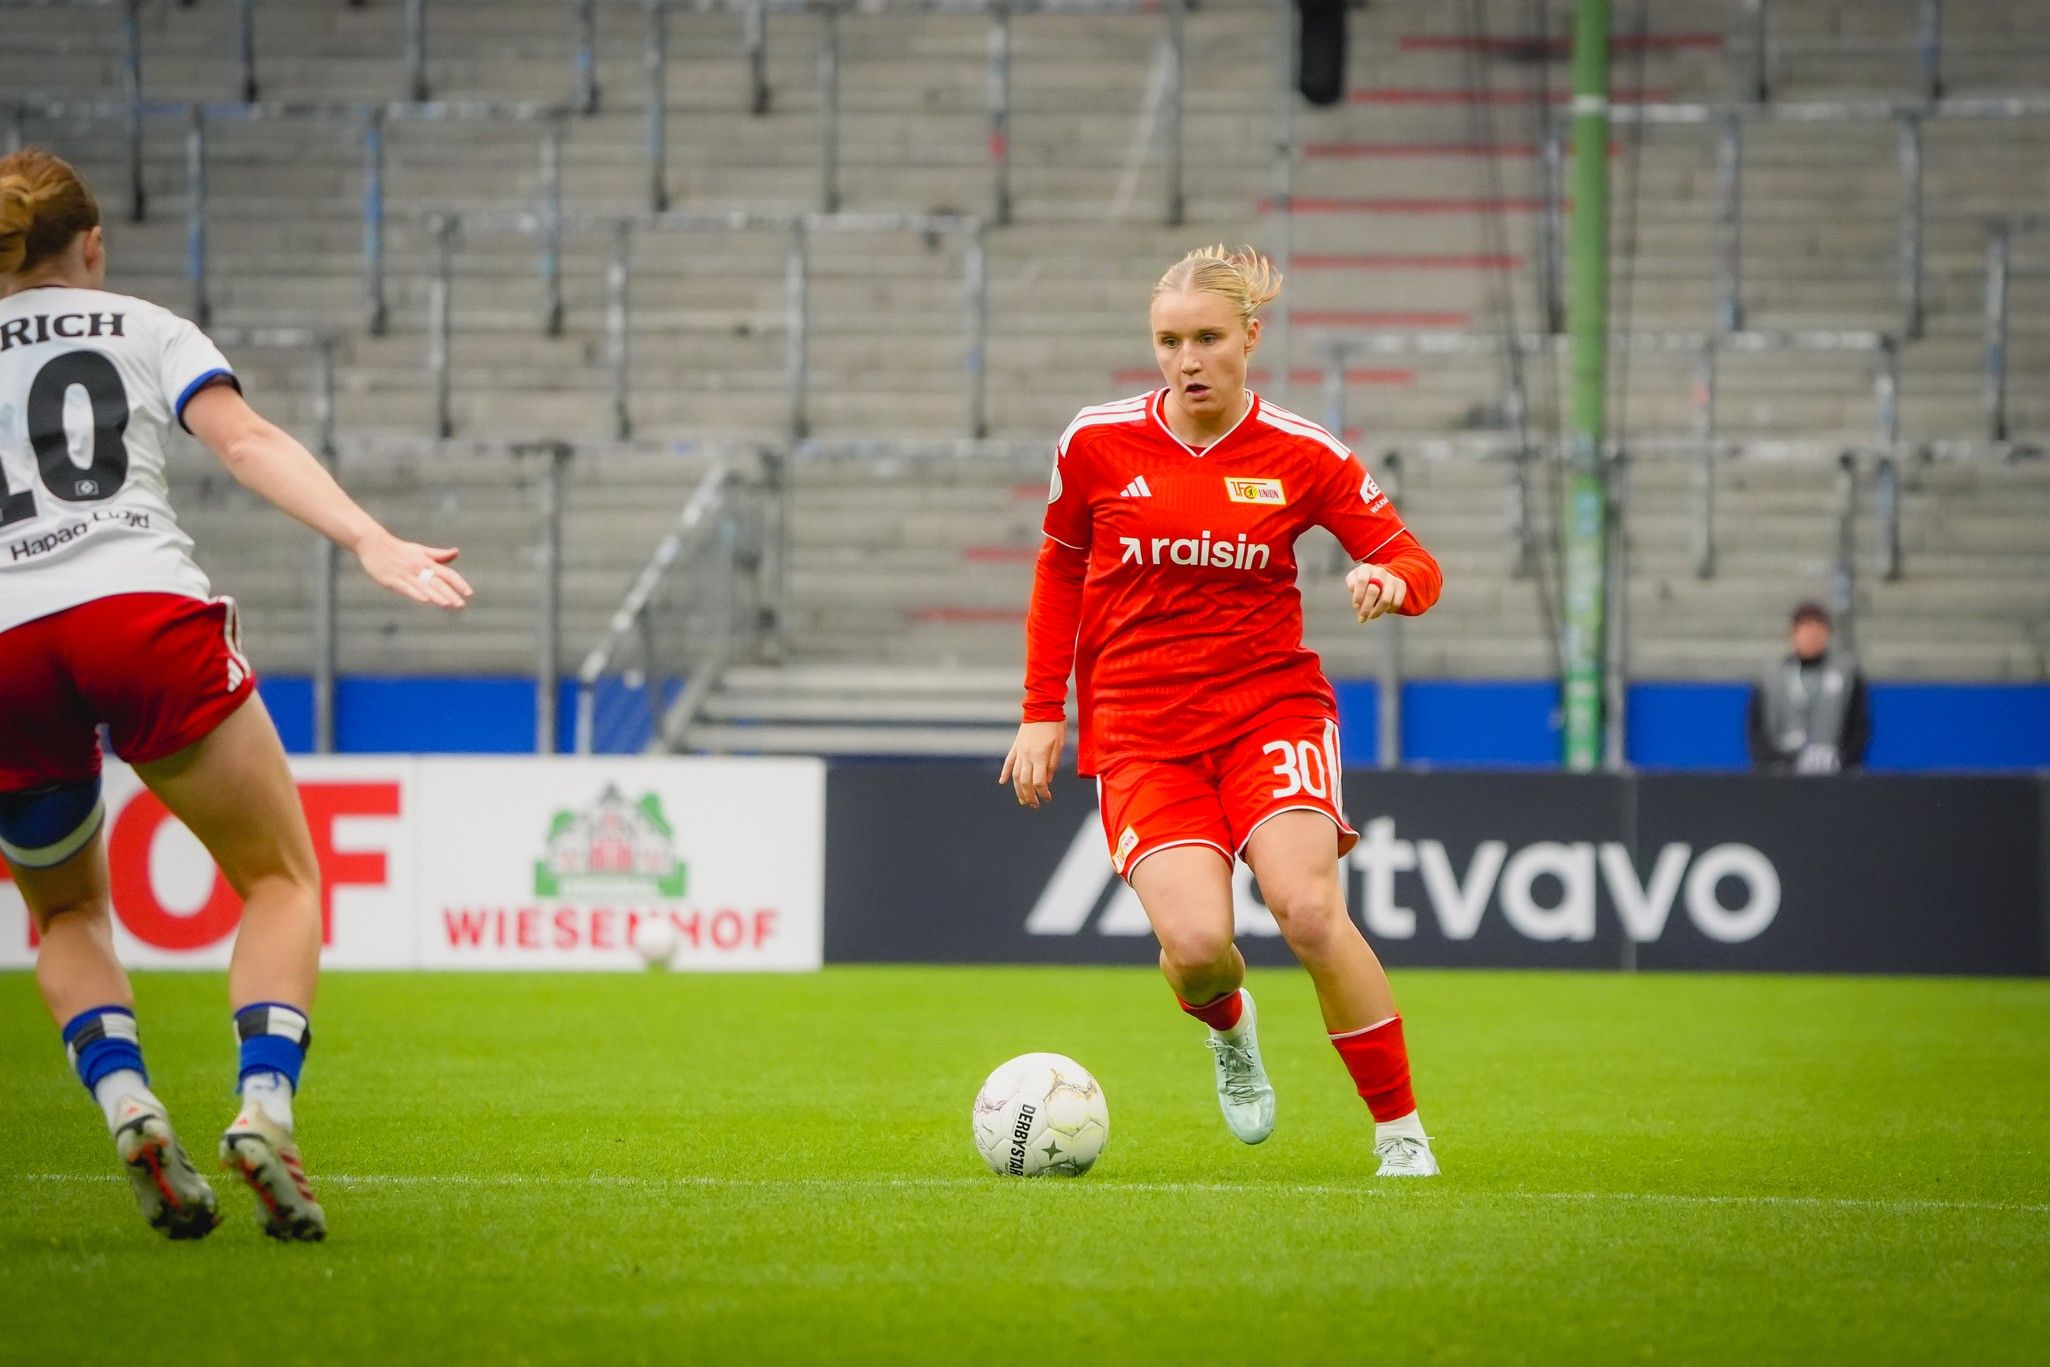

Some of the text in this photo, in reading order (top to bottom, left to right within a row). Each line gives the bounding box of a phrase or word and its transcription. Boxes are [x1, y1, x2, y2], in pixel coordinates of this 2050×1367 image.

[0, 312, 125, 351] RICH
[1152, 530, 1270, 570] raisin
[1262, 740, 1327, 798] 30
[0, 781, 401, 953] OF
[1232, 817, 1781, 943] tvavo
